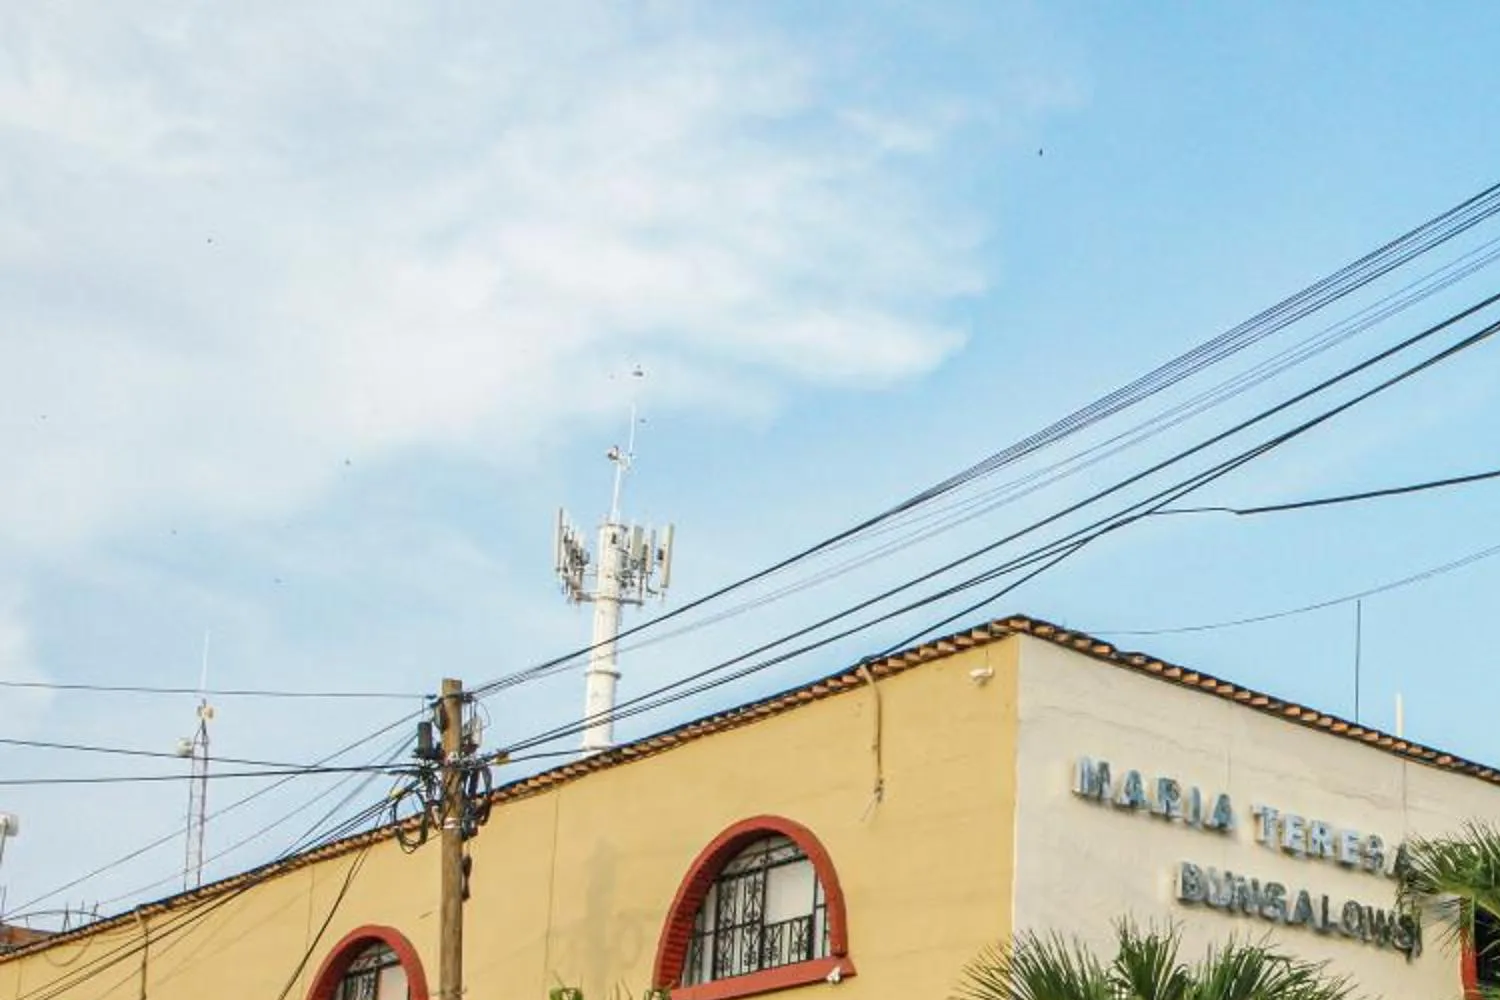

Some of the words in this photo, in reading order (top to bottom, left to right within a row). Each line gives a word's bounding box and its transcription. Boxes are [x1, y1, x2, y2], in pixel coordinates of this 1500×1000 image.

[1074, 755, 1237, 832] MARIA
[1253, 803, 1417, 882] TERESA
[1176, 860, 1421, 955] BUNGALOWS
